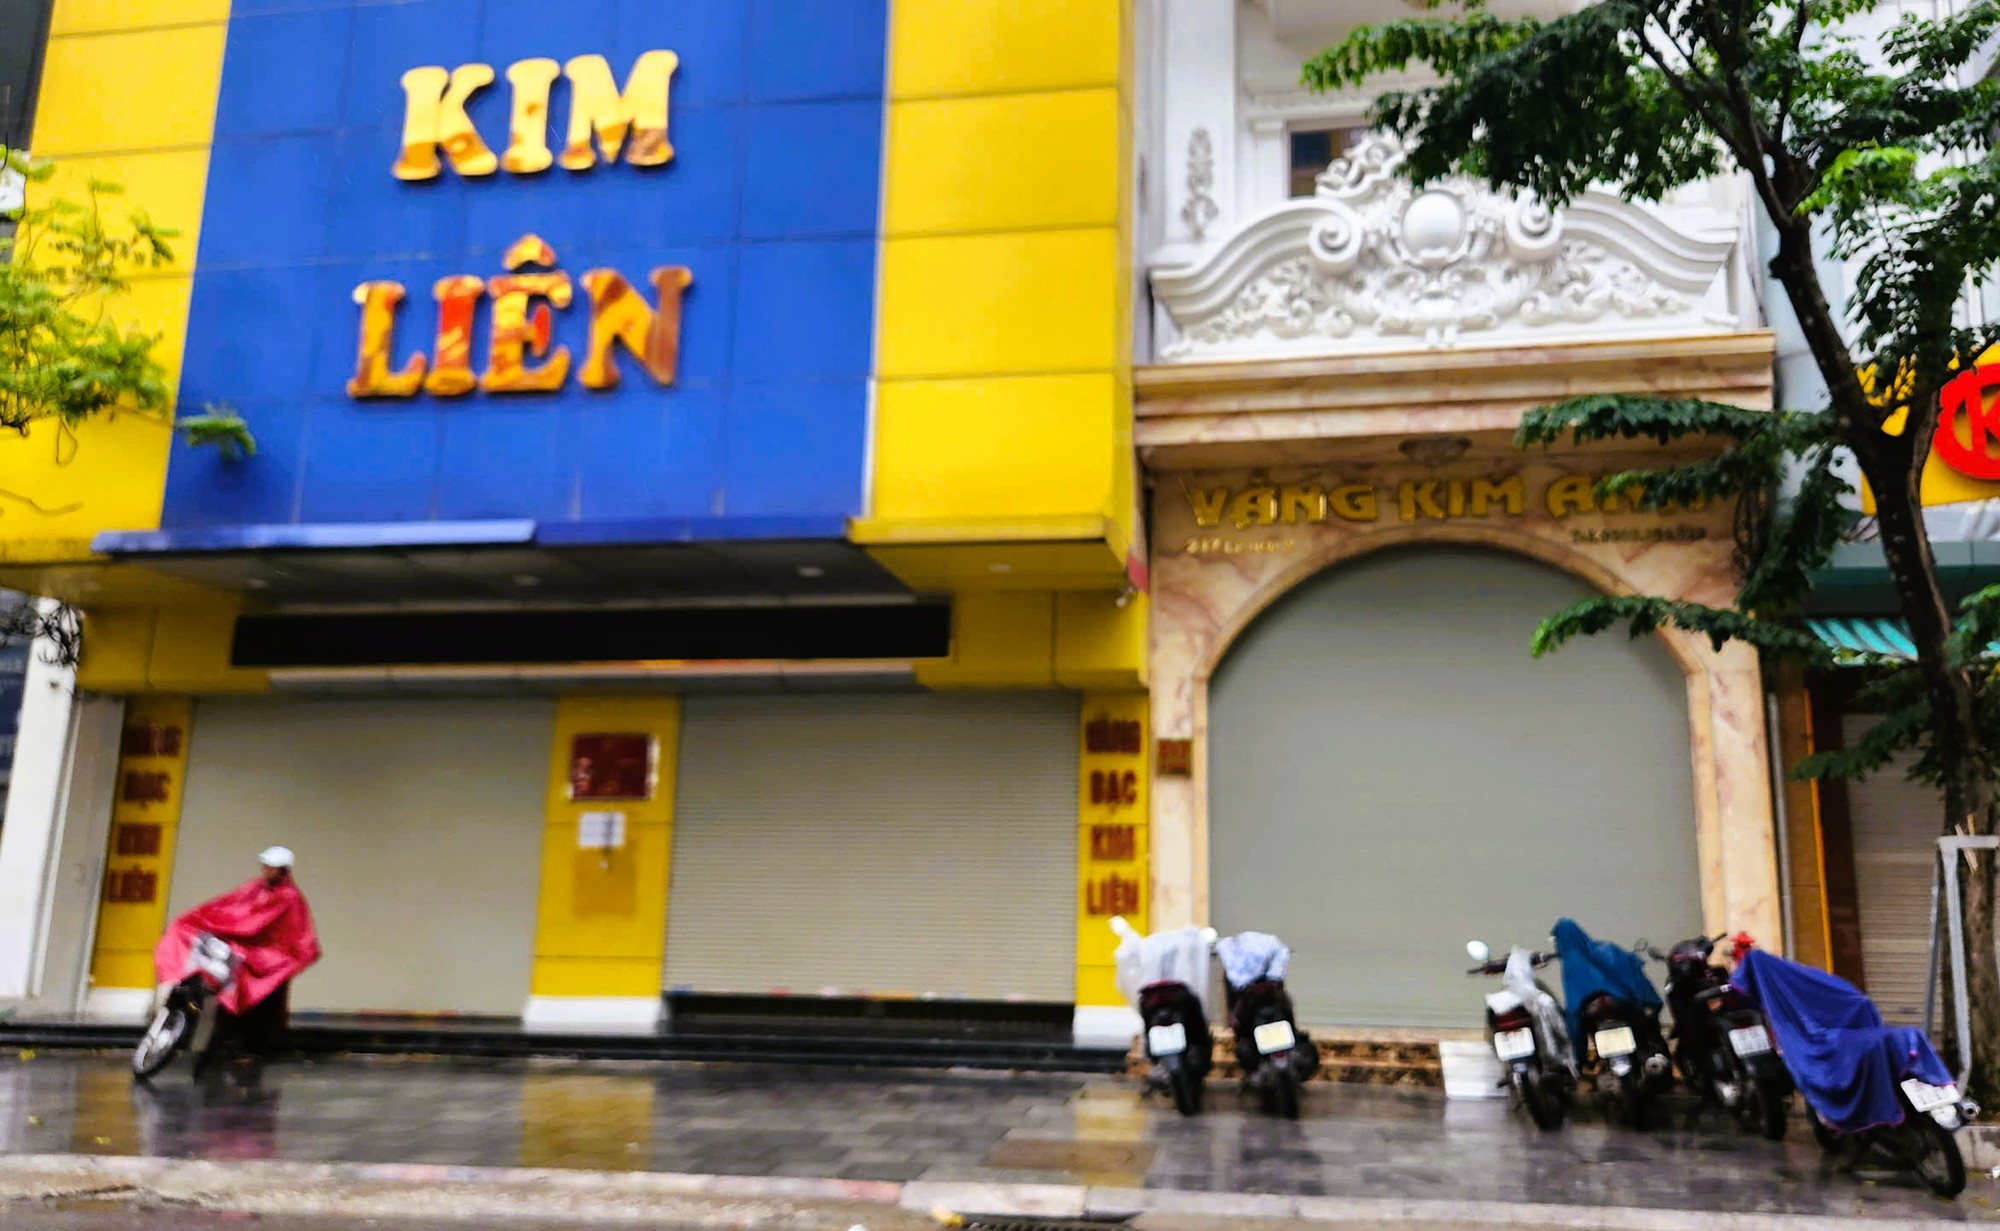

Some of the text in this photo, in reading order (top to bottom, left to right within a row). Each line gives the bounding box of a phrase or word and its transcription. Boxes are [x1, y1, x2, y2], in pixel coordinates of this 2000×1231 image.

[392, 49, 680, 182] KIM
[346, 233, 693, 397] LIÊN
[1398, 475, 1523, 521] KIM
